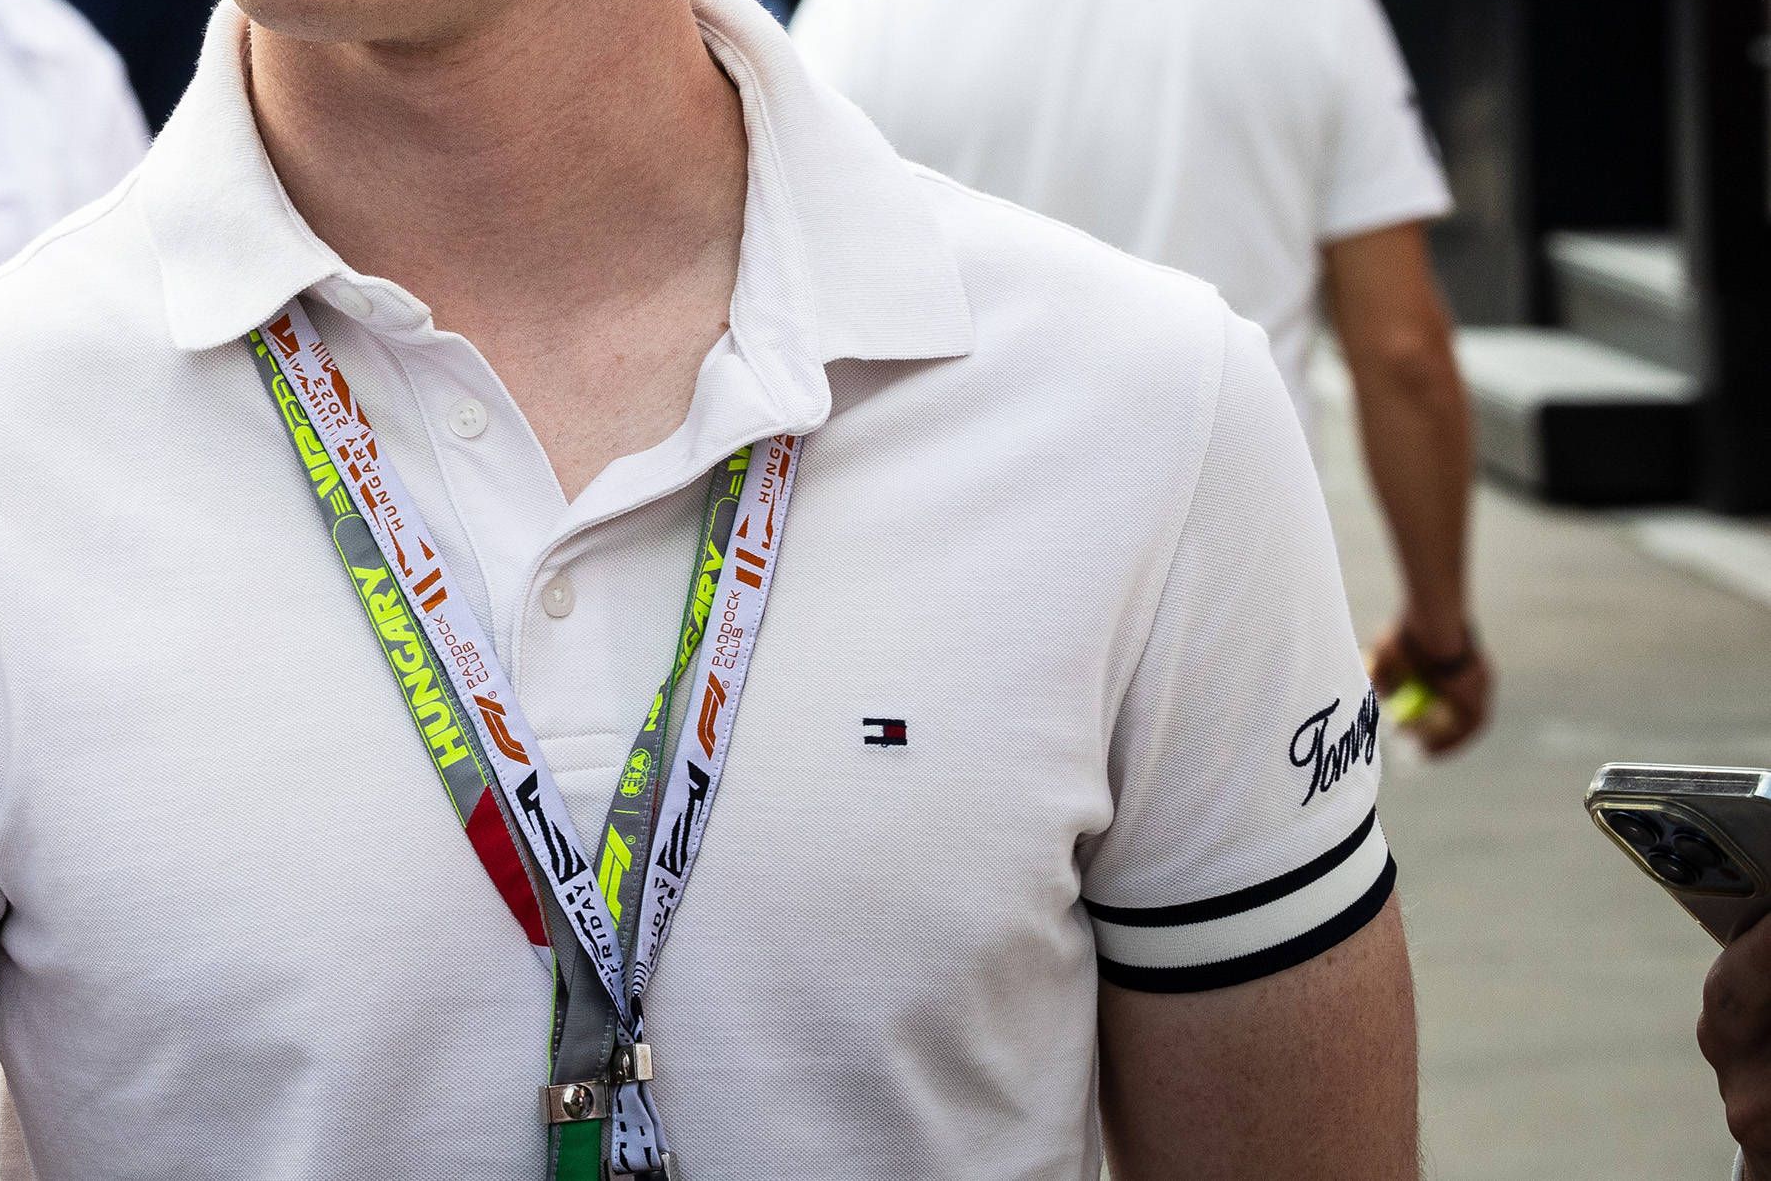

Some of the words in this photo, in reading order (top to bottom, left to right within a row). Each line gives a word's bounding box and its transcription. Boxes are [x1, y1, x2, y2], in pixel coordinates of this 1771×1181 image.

[313, 378, 348, 428] 2023
[345, 437, 406, 531] HUNGARY
[759, 433, 786, 504] HUNGA
[434, 614, 478, 690] PADDOCK
[461, 641, 489, 686] CLUB
[712, 590, 742, 667] PADDOCK
[724, 627, 744, 669] CLUB
[355, 566, 471, 769] HUNGARY
[622, 752, 647, 795] FIA
[574, 884, 619, 973] FRIDAY
[649, 878, 670, 957] RIDAY
